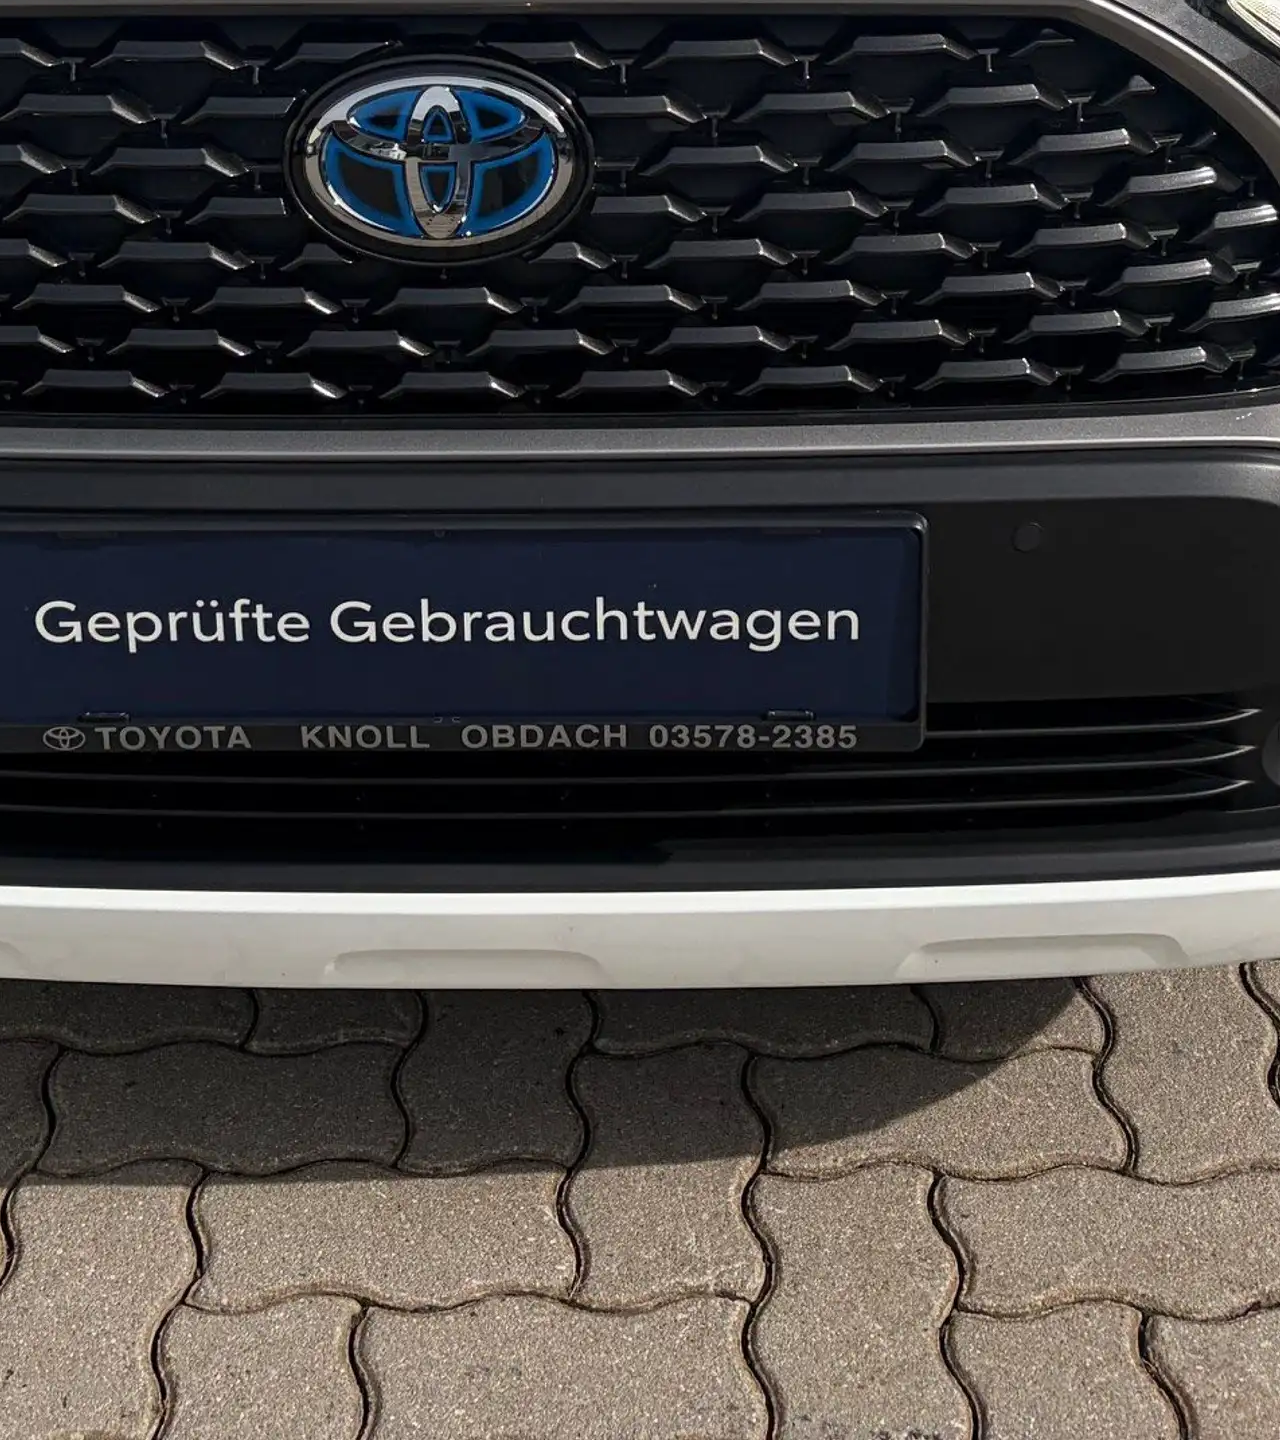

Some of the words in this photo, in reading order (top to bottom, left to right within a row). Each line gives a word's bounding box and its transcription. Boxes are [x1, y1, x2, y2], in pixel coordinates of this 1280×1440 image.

[35, 598, 310, 653] Geprüfte
[330, 596, 859, 652] Gebrauchtwagen
[94, 726, 251, 750] TOYOTA
[301, 725, 430, 749] KNOLL
[461, 724, 627, 749] OBDACH
[649, 724, 857, 749] 03578-2385
